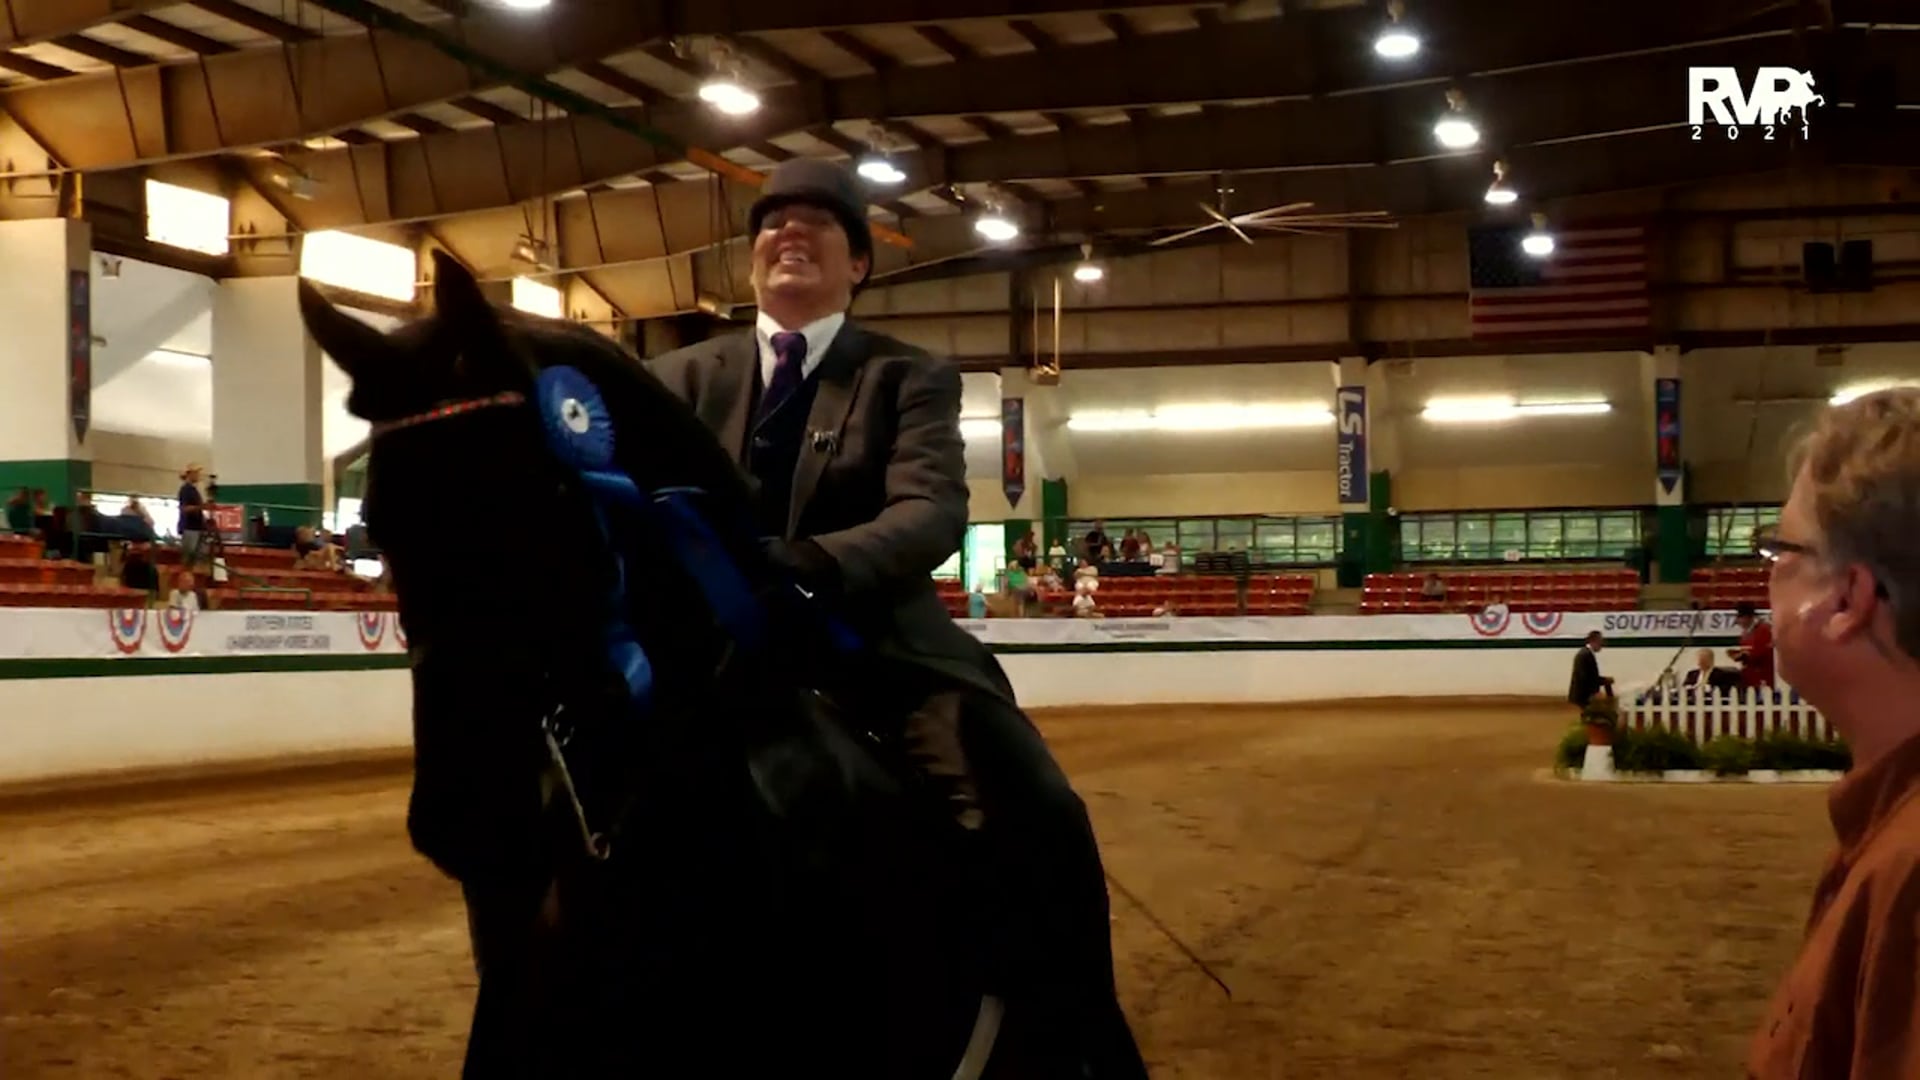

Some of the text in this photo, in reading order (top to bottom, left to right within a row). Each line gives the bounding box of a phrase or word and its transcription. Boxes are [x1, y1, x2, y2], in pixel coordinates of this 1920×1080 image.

[1339, 391, 1363, 497] LS Tractor
[1604, 613, 1704, 631] SOUTHERN
